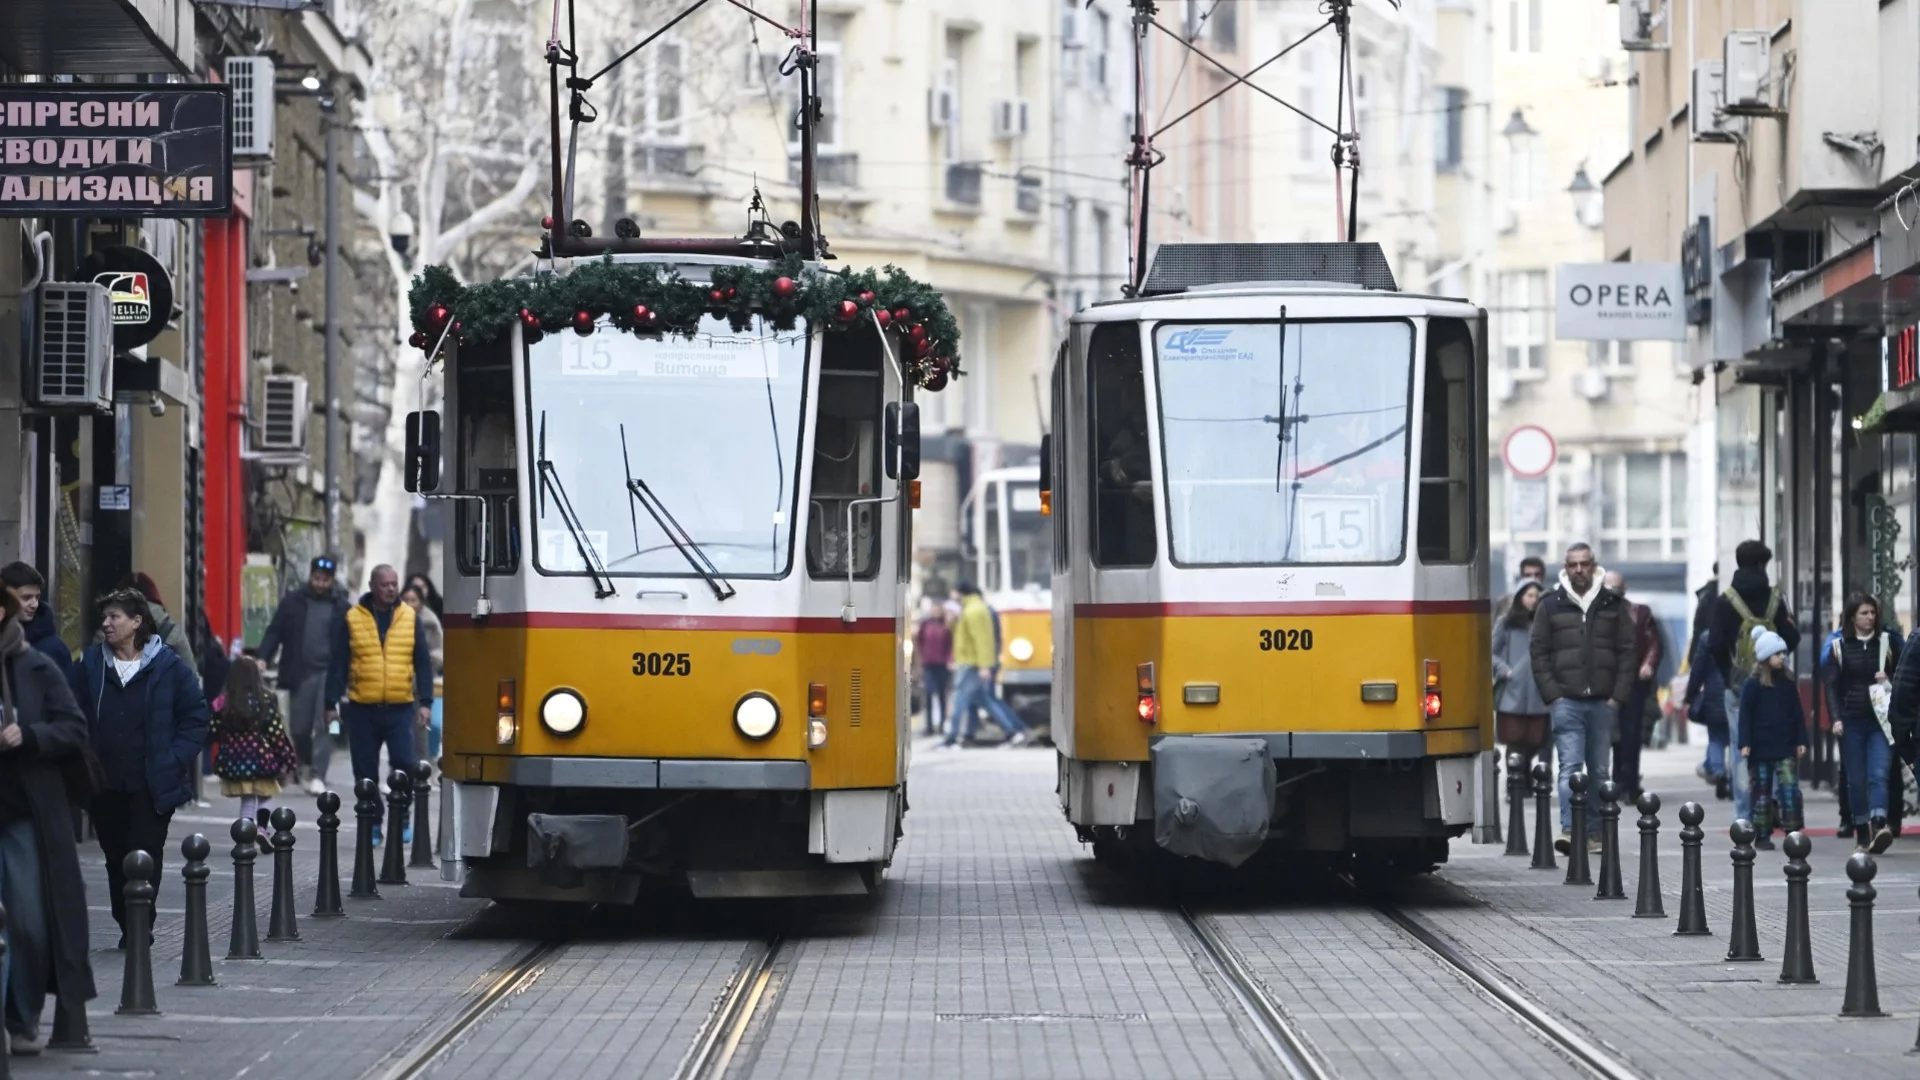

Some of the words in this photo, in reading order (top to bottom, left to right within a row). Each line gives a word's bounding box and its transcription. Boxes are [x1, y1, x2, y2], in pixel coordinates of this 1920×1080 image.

[0, 101, 160, 127] ПРЕСНИ
[0, 139, 117, 168] ВОДИ
[128, 139, 152, 164] И
[0, 176, 213, 205] АЛИЗАЦИЯ
[1570, 284, 1672, 306] OPERA
[568, 339, 613, 371] 15
[654, 361, 728, 376] Витоша
[1310, 509, 1363, 549] 15
[1259, 629, 1313, 651] 3020
[632, 652, 691, 676] 3025
